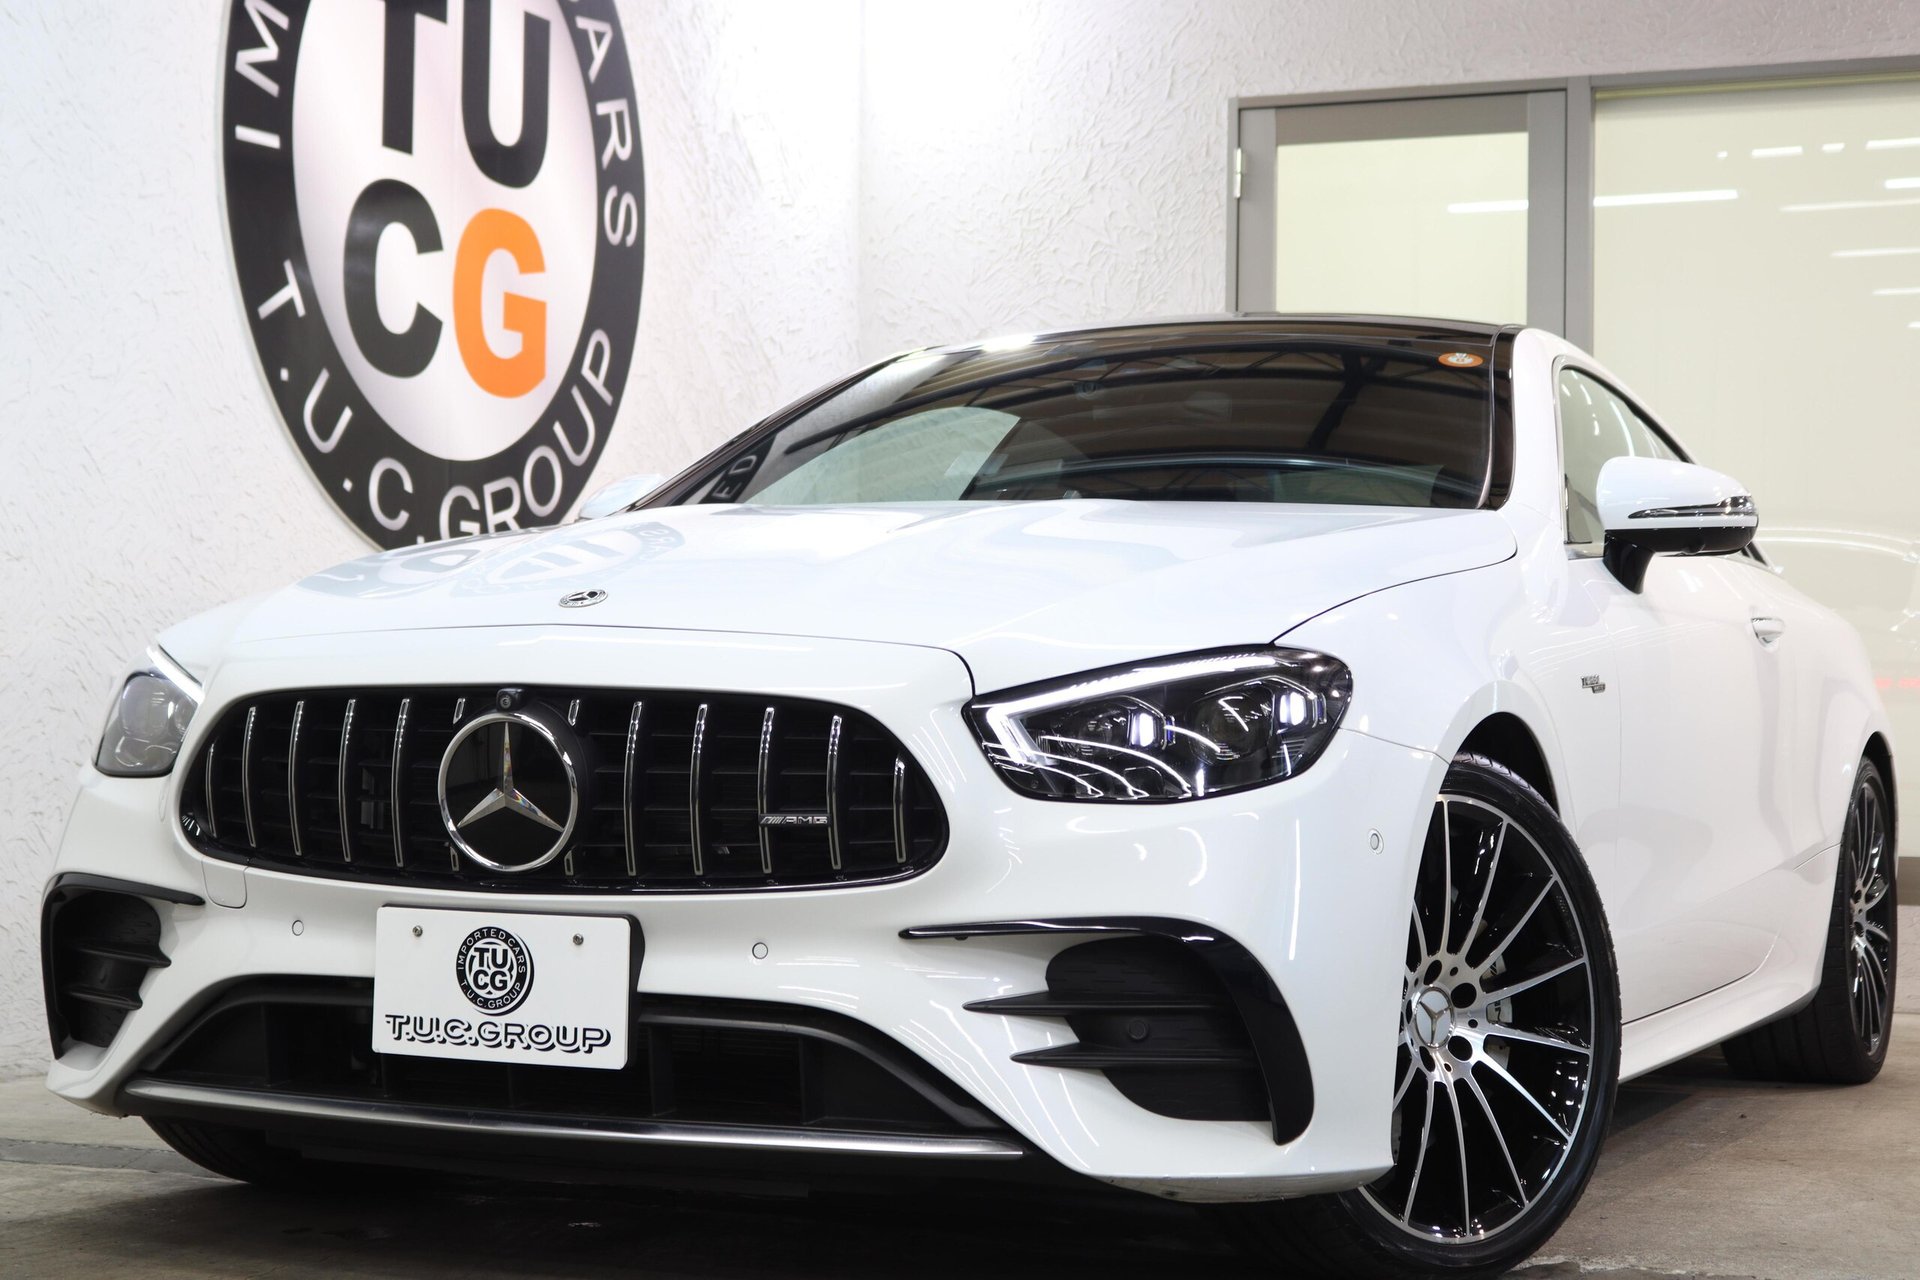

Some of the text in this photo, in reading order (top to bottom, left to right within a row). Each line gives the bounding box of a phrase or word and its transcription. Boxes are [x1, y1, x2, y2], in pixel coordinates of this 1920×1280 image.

[382, 0, 551, 189] TU
[343, 178, 547, 398] CG
[457, 928, 526, 973] IMPORTED CARS
[385, 1014, 611, 1053] T.U.C.GROUP
